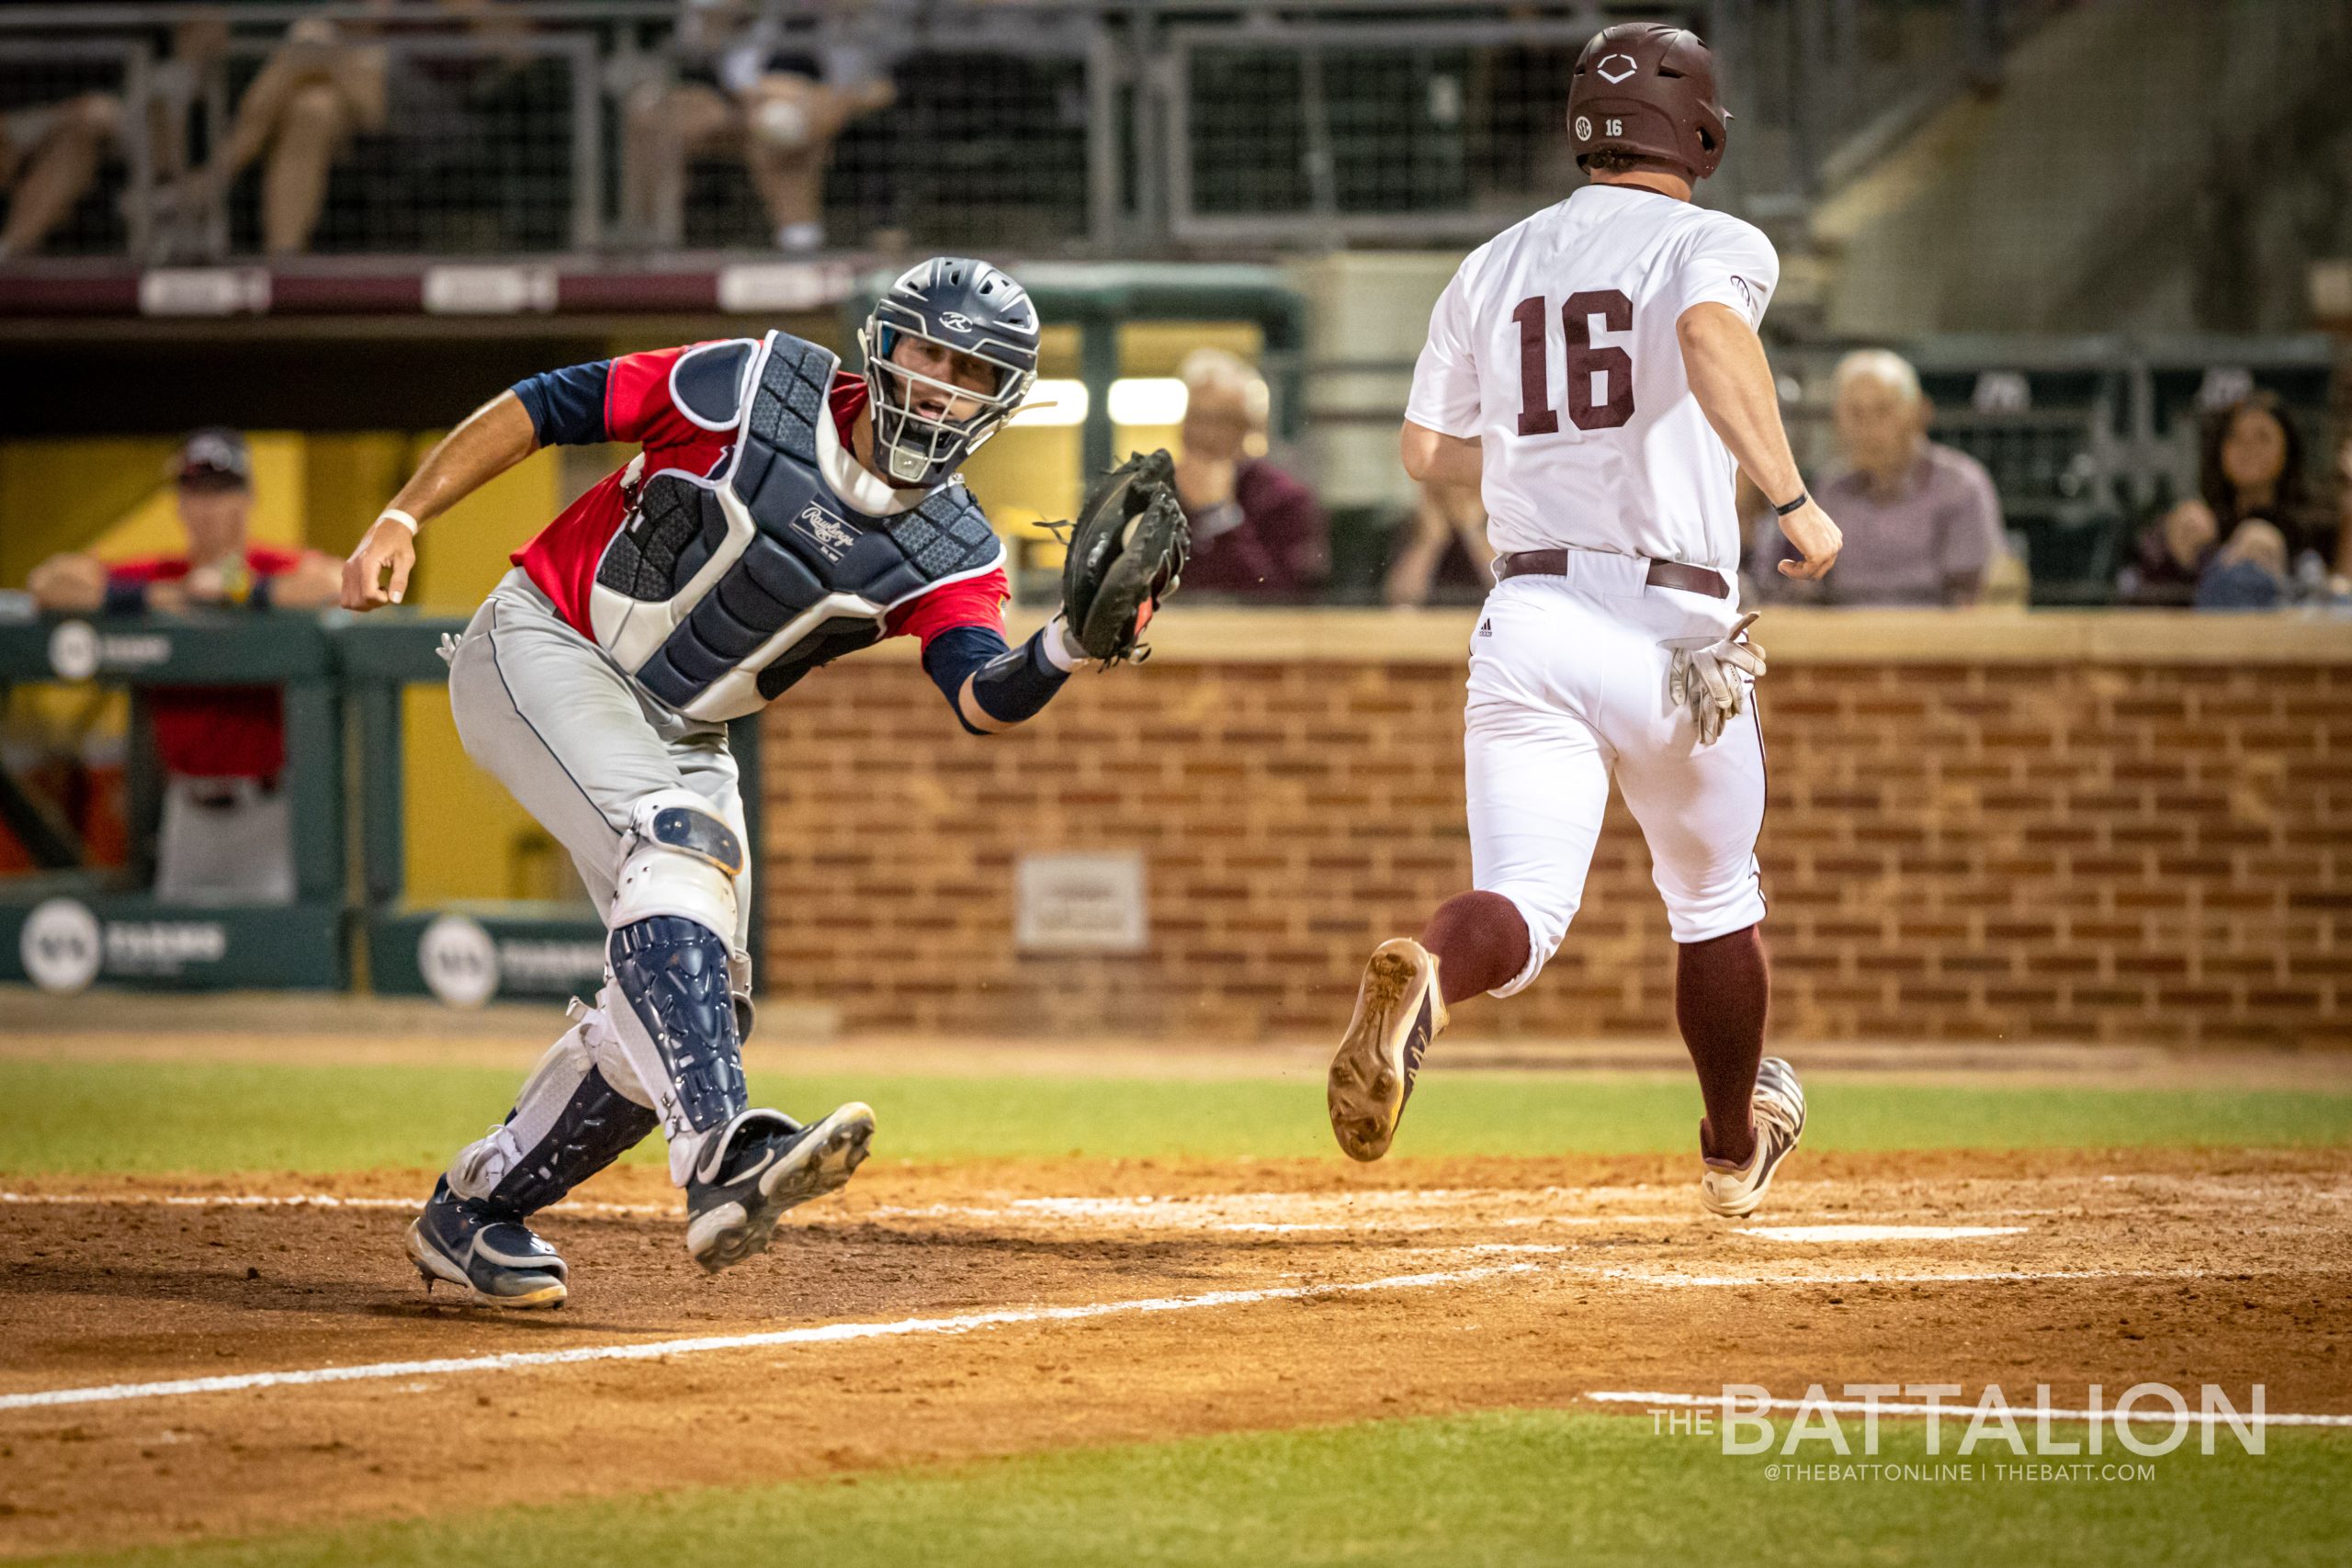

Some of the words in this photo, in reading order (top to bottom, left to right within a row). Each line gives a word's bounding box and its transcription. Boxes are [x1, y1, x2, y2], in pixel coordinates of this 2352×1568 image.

[1605, 118, 1623, 137] 16
[1512, 288, 1635, 437] 16
[801, 506, 854, 547] Rawlings
